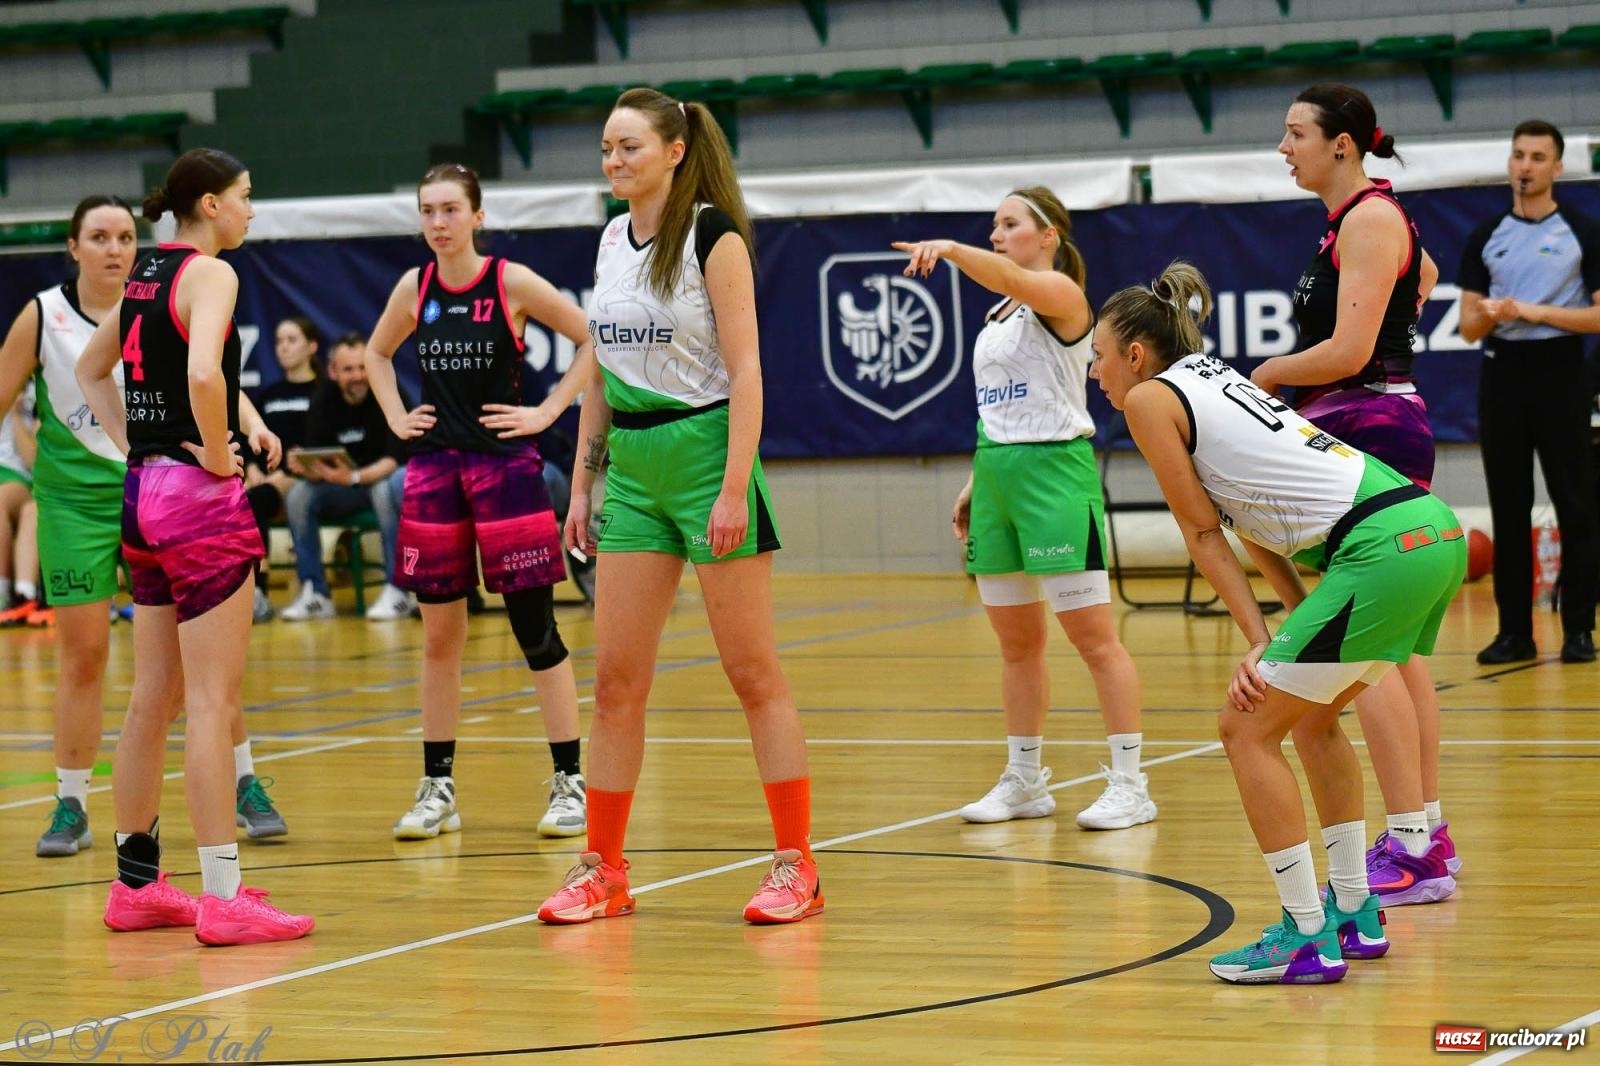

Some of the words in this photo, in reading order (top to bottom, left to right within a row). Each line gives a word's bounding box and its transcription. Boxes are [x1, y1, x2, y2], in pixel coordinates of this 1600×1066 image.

[473, 299, 495, 322] 17
[599, 321, 674, 344] Clavis
[122, 314, 145, 381] 4
[419, 339, 495, 355] GÓRSKIE
[503, 546, 550, 563] GÓRSKIE
[505, 556, 551, 572] RESORTY
[51, 569, 94, 597] 24
